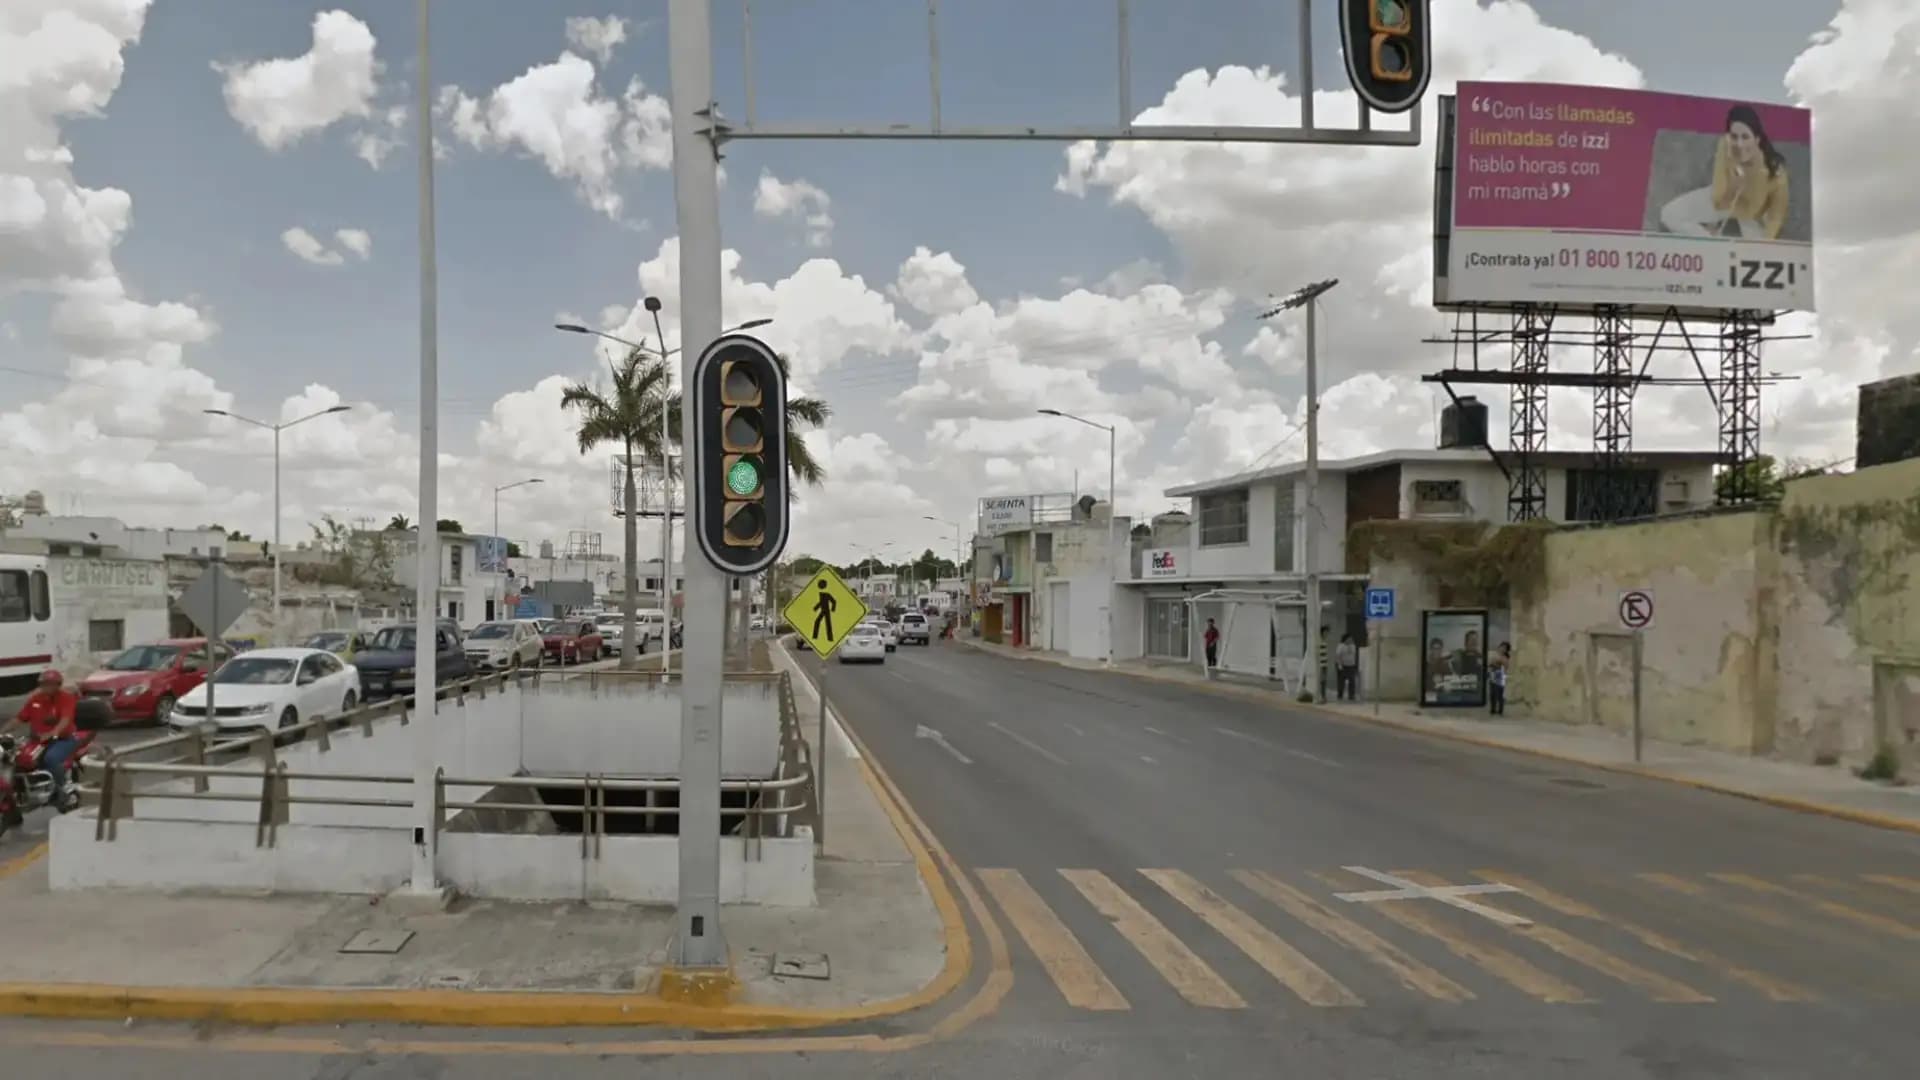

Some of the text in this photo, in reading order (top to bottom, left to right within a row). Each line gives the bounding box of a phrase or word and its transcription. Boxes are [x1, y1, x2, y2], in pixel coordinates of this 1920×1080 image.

[1529, 101, 1553, 120] las
[1558, 103, 1635, 125] llamadas
[1469, 128, 1609, 149] ilimitadas de izzi
[1469, 154, 1600, 175] hablo horas con
[1468, 182, 1490, 198] mi
[1465, 249, 1703, 272] ¡Contrata ya! 01 800 120 4000
